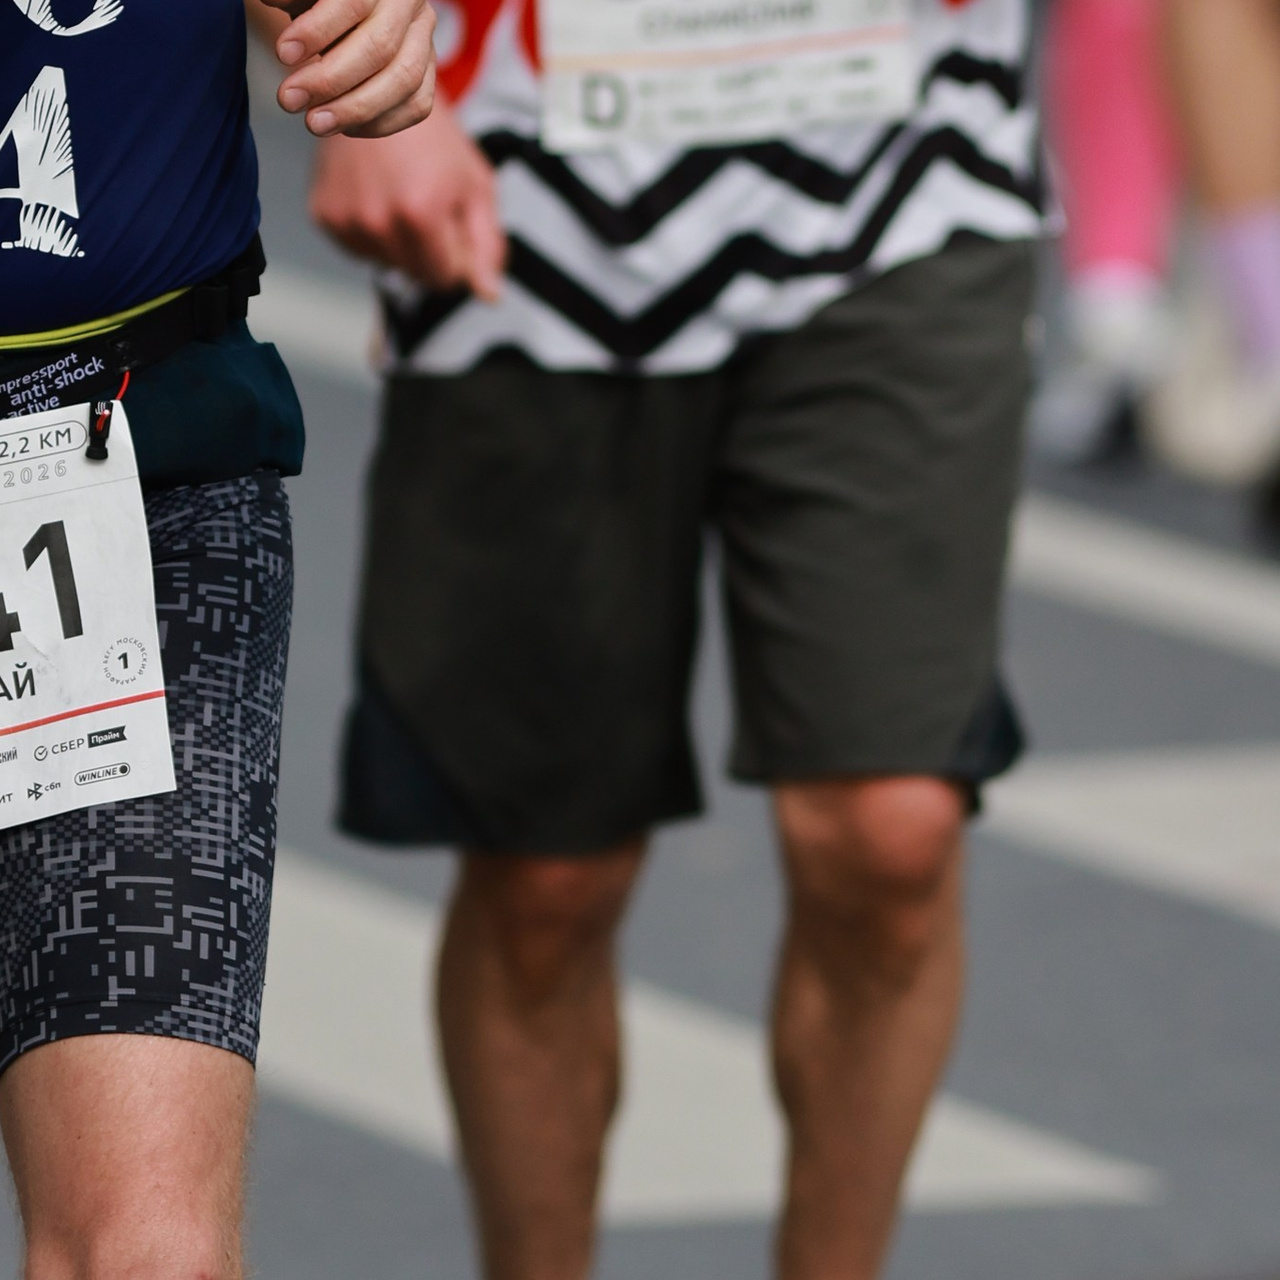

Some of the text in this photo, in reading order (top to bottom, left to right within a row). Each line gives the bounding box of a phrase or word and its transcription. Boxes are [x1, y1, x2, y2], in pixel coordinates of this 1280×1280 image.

[11, 356, 105, 406] anti-shock
[40, 428, 71, 450] КМ
[4, 460, 67, 488] 2026
[117, 651, 129, 670] 1
[51, 731, 120, 755] СБЕР Прайм
[78, 767, 118, 782] WINLINE
[44, 781, 61, 792] сбп
